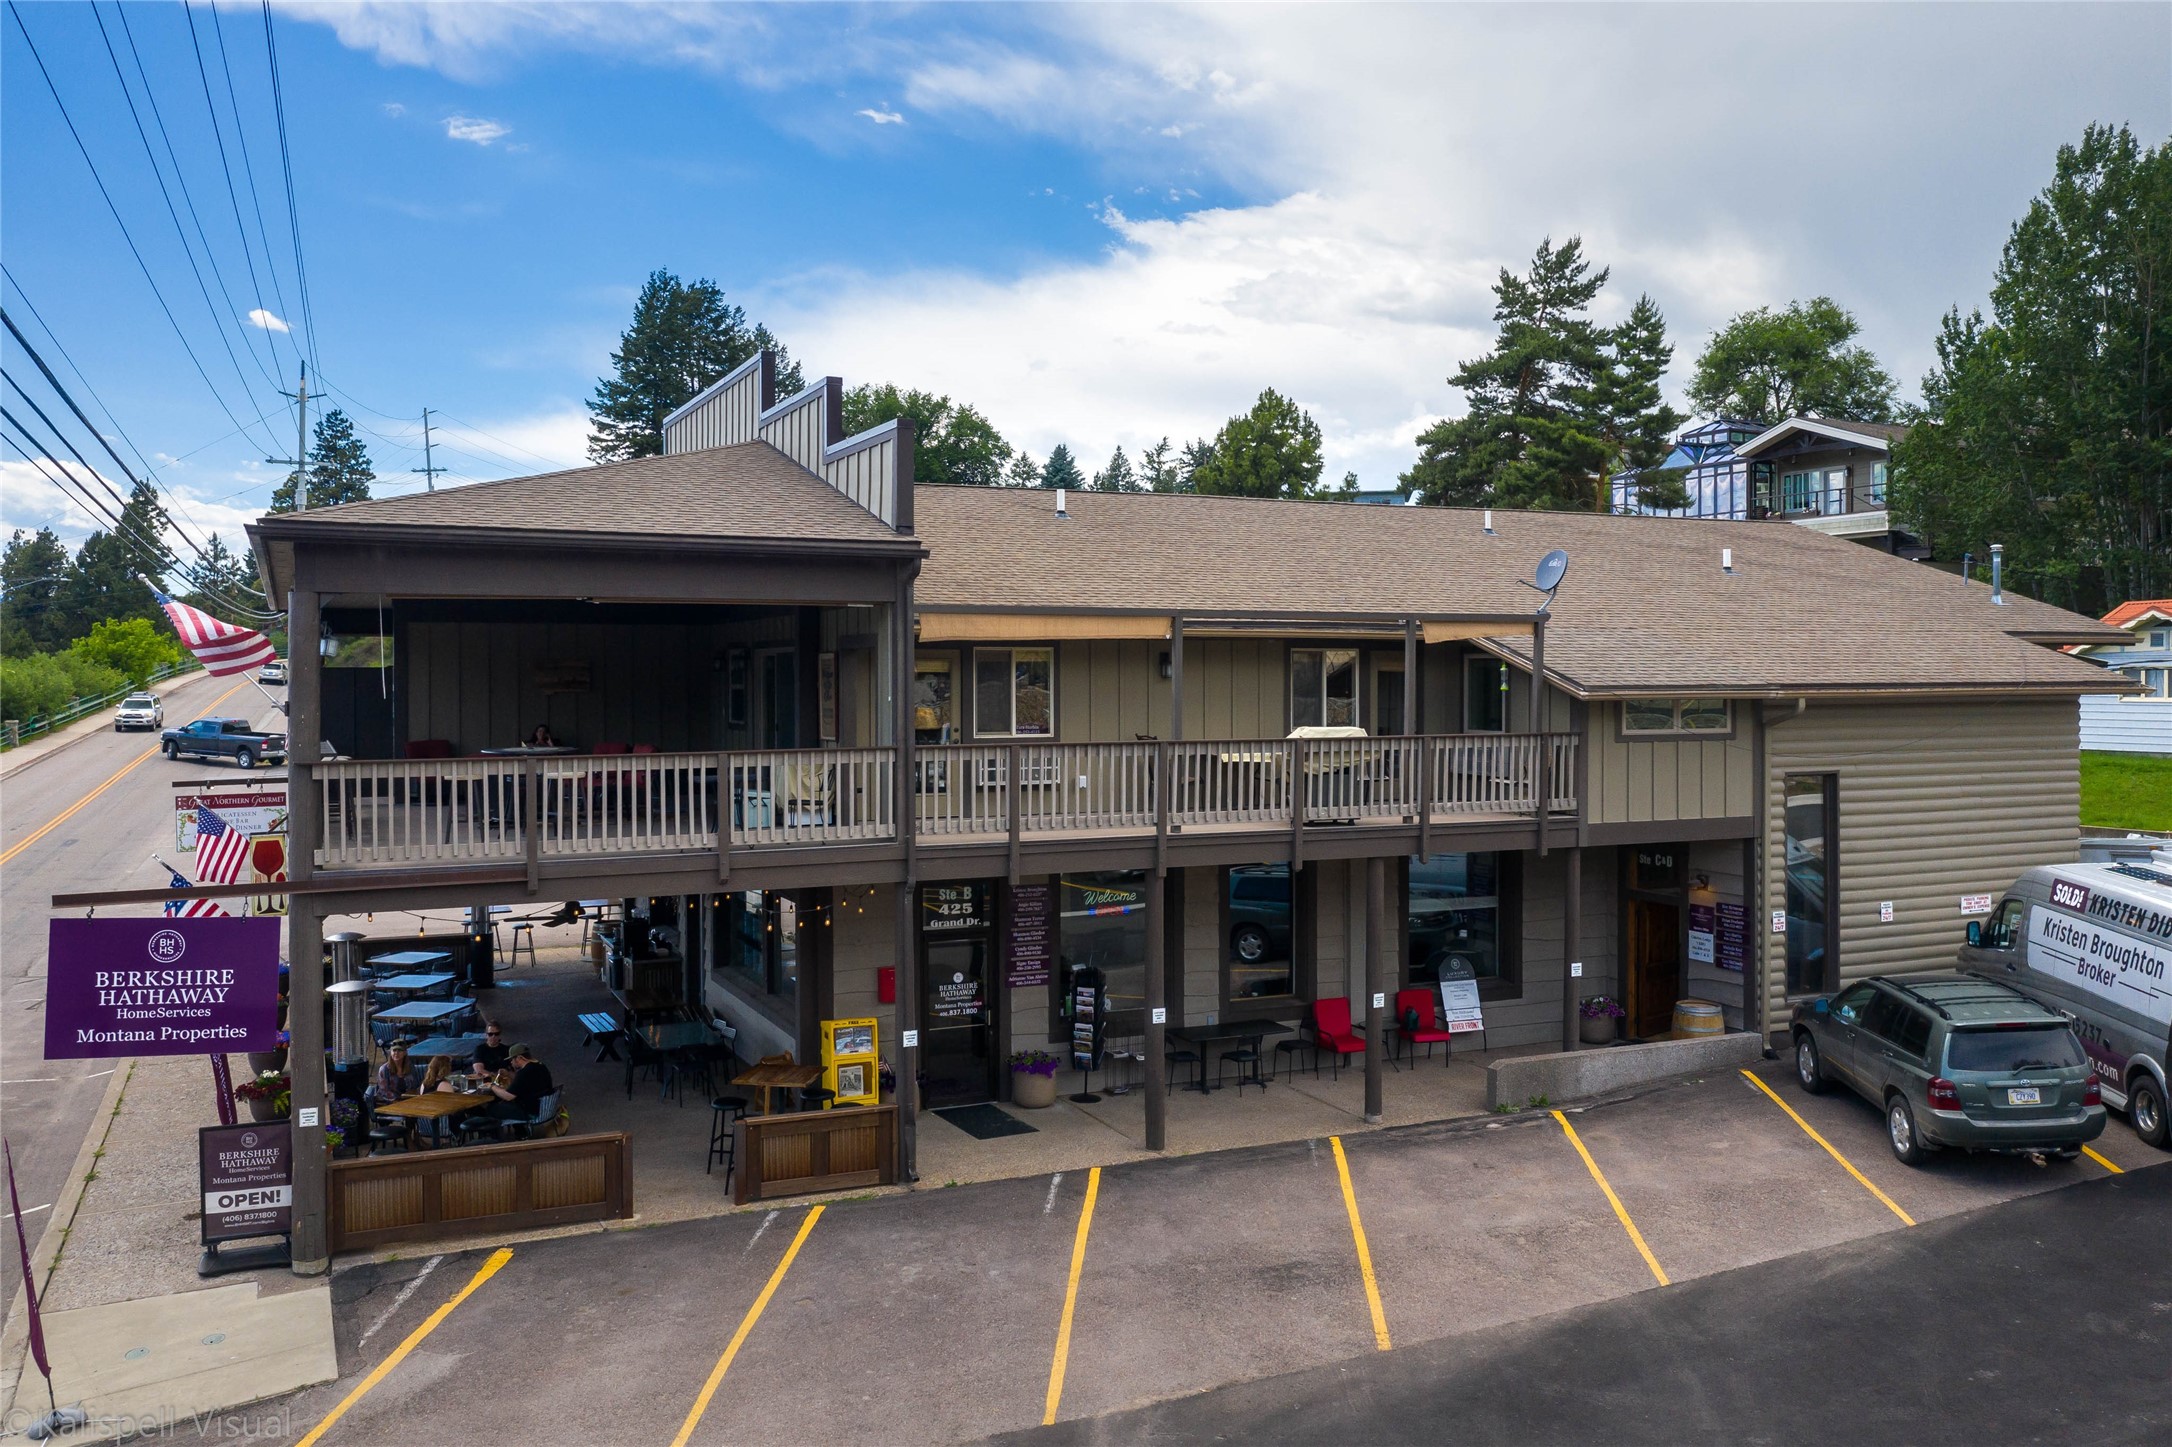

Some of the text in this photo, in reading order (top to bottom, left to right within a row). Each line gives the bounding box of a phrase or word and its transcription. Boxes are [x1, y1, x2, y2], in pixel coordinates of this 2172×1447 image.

[939, 886, 972, 900] Ste B
[1083, 889, 1137, 906] Welcome
[2053, 883, 2085, 908] SOLD!
[938, 902, 973, 915] 425
[2088, 893, 2147, 929] KRISTEN
[930, 917, 981, 928] Grand Dr.
[159, 938, 175, 947] BH
[2043, 916, 2164, 980] Kristen Broughton
[159, 946, 174, 955] HS
[94, 969, 235, 988] BERKSHIRE
[2077, 956, 2116, 988] Broker
[939, 982, 978, 991] BERKSHIRE
[940, 989, 977, 997] HATHAWAY
[98, 987, 230, 1006] HATHAWAY
[116, 1006, 211, 1020] HomeServices
[1451, 1021, 1479, 1031] RIVER FRONT
[76, 1024, 248, 1044] Montana Properties
[219, 1147, 280, 1161] BERKSHIRE
[221, 1156, 278, 1168] HATHAWAY
[228, 1165, 271, 1174] HomeServices
[212, 1172, 287, 1185] Montana Properties
[218, 1189, 281, 1209] OPEN!
[222, 1214, 243, 1224] (406)
